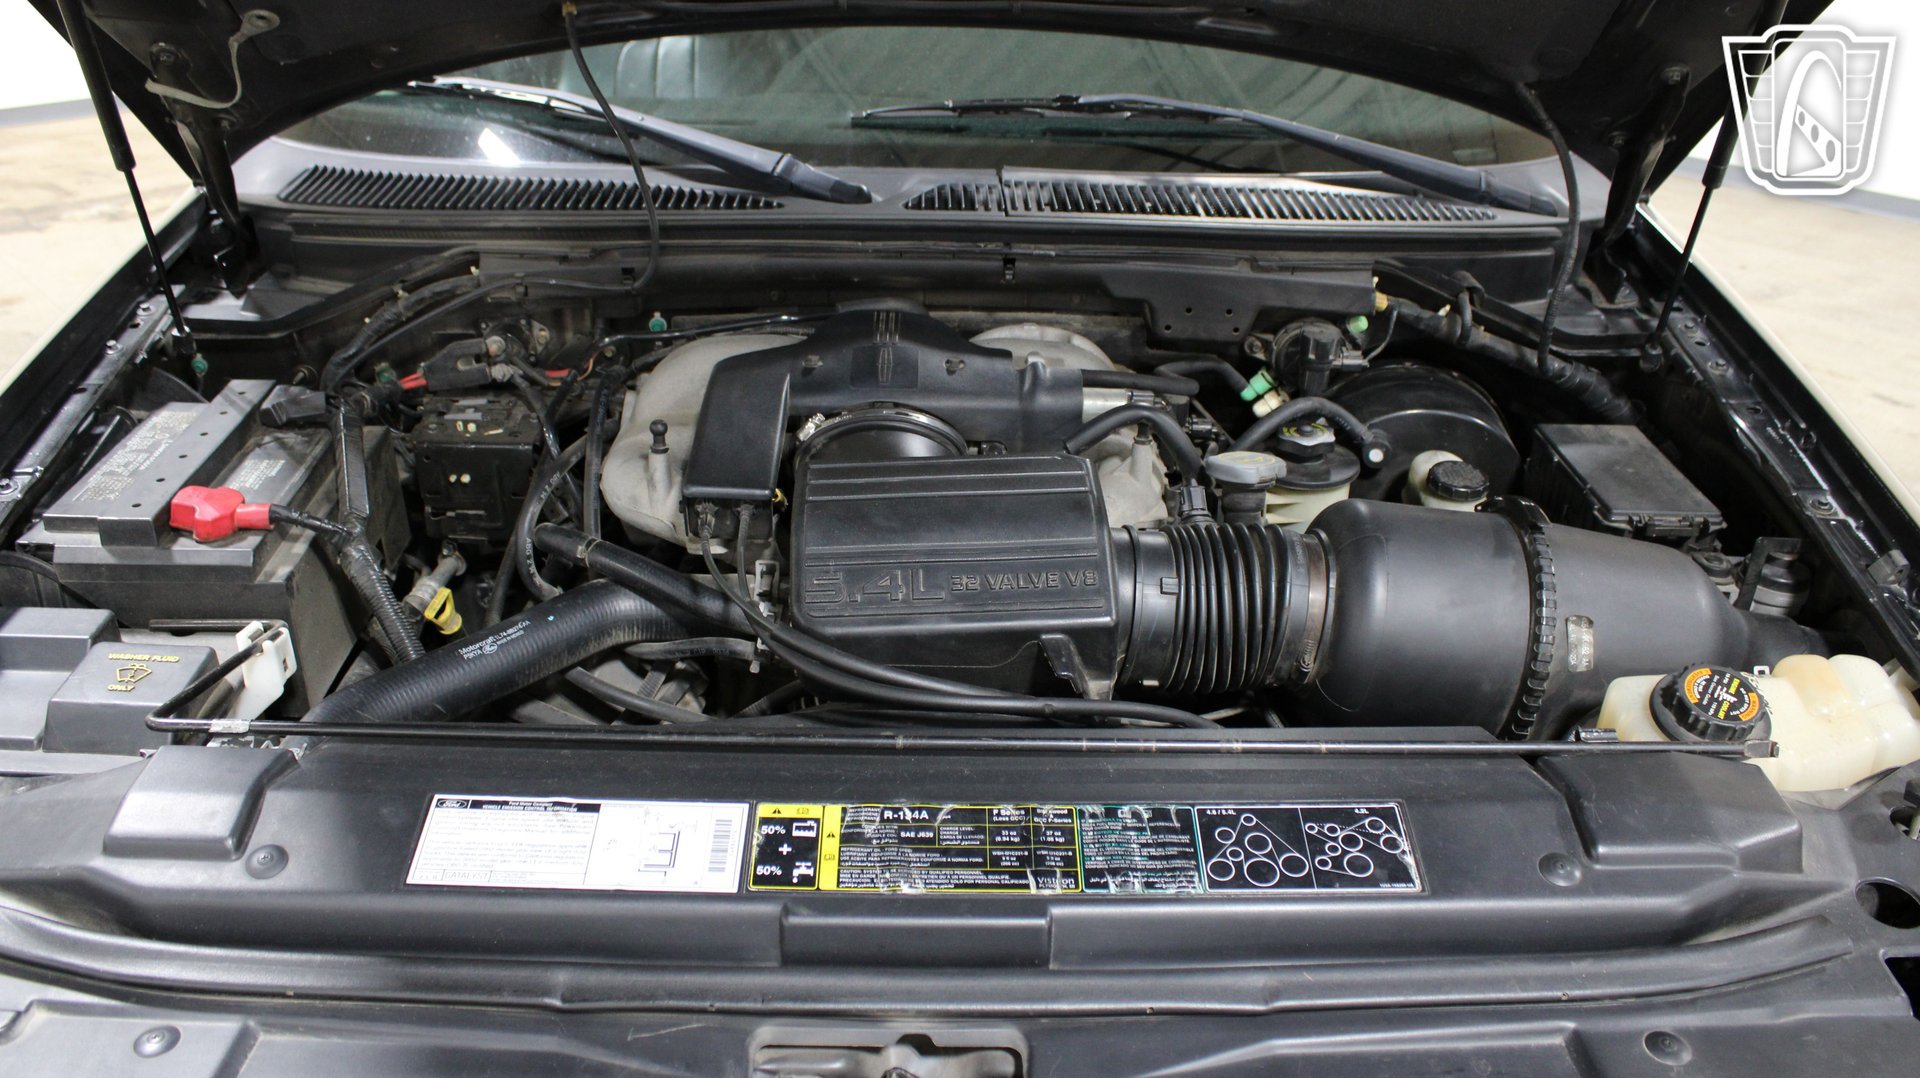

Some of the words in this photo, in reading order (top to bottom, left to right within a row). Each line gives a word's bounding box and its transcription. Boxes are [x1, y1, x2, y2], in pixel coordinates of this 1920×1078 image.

[804, 568, 944, 605] 5.4L
[951, 575, 979, 592] 32
[985, 572, 1059, 590] VALVE
[1063, 571, 1098, 588] V8
[458, 635, 496, 655] Motorcraft
[108, 653, 151, 661] WASHER
[151, 655, 180, 663] FLUID
[107, 684, 136, 692] ONLY
[1728, 677, 1740, 695] ENGINE
[1717, 700, 1731, 720] COOLANT
[443, 800, 462, 808] Ford
[884, 810, 929, 820] R-134A
[761, 825, 786, 835] 50%
[445, 871, 488, 880] CATALYST
[756, 865, 782, 876] 50%
